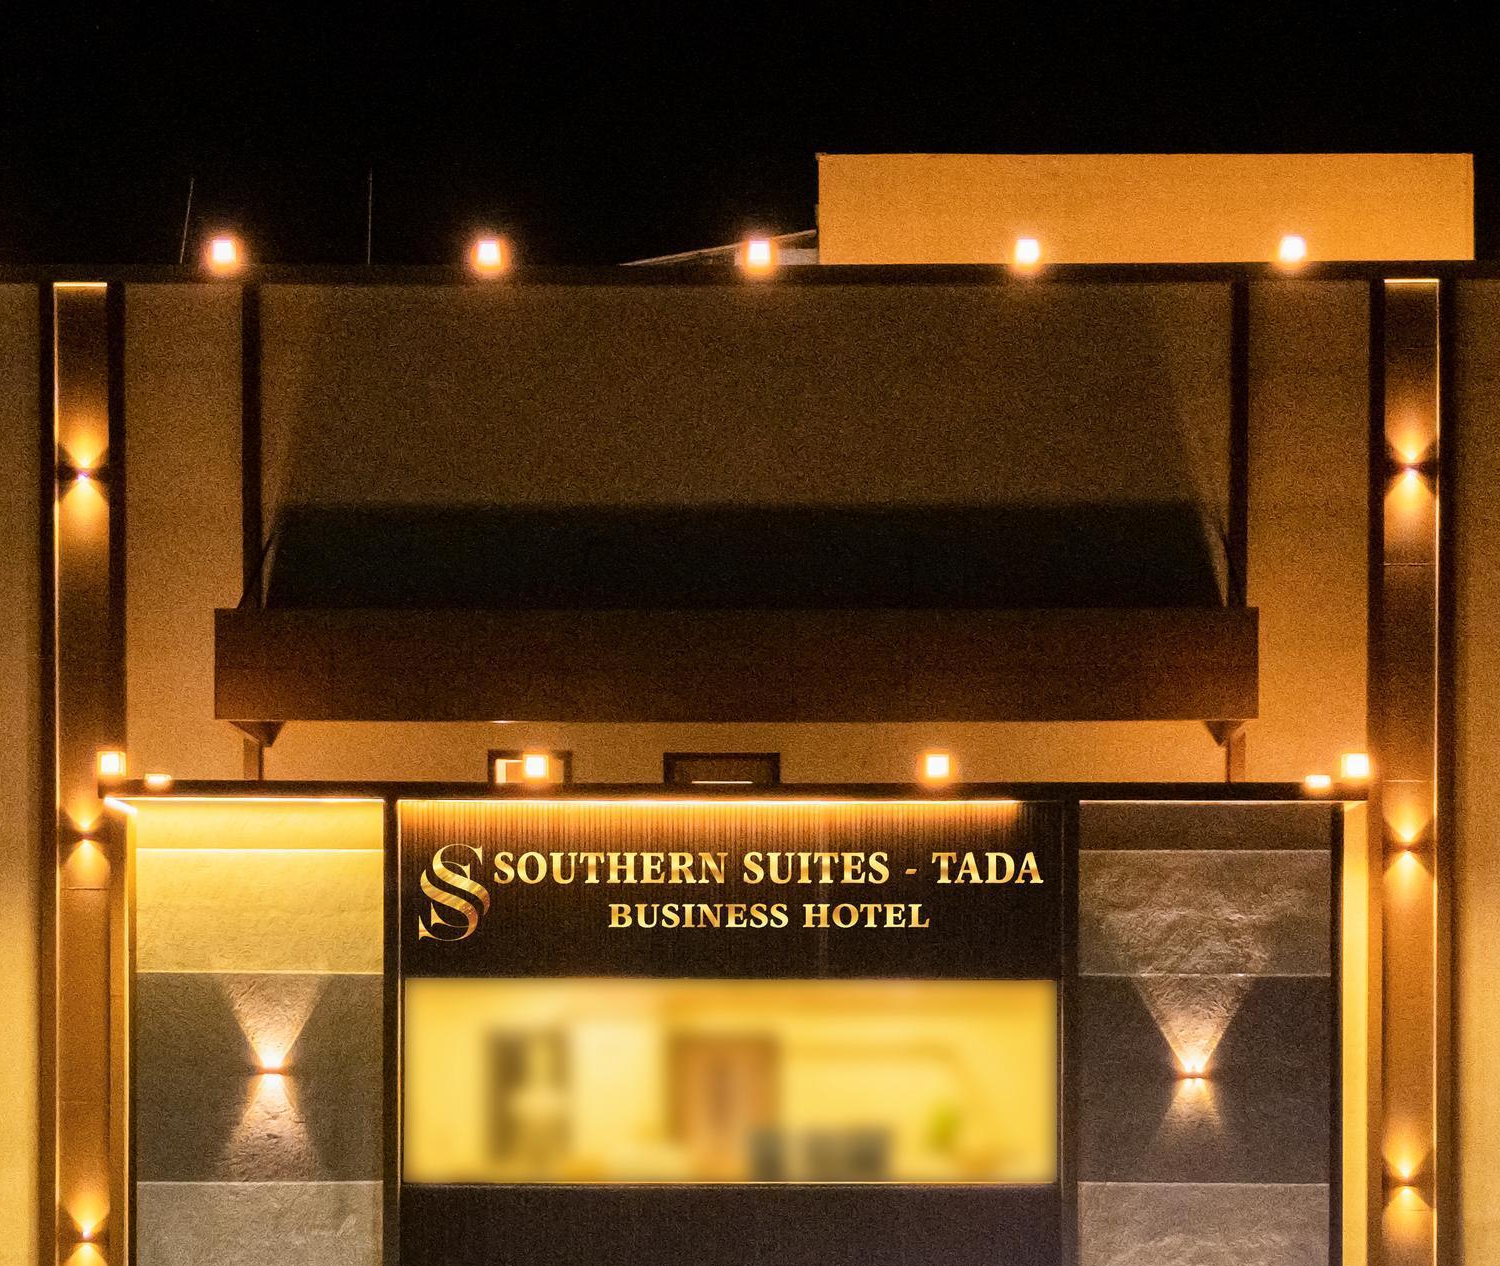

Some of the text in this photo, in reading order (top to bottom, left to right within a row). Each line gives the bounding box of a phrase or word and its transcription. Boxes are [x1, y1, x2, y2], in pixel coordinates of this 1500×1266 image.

[493, 851, 727, 884] SOUTHERN
[743, 851, 889, 884] SUITES
[932, 852, 1044, 884] TADA
[608, 903, 930, 929] BUSINESS HOTEL
